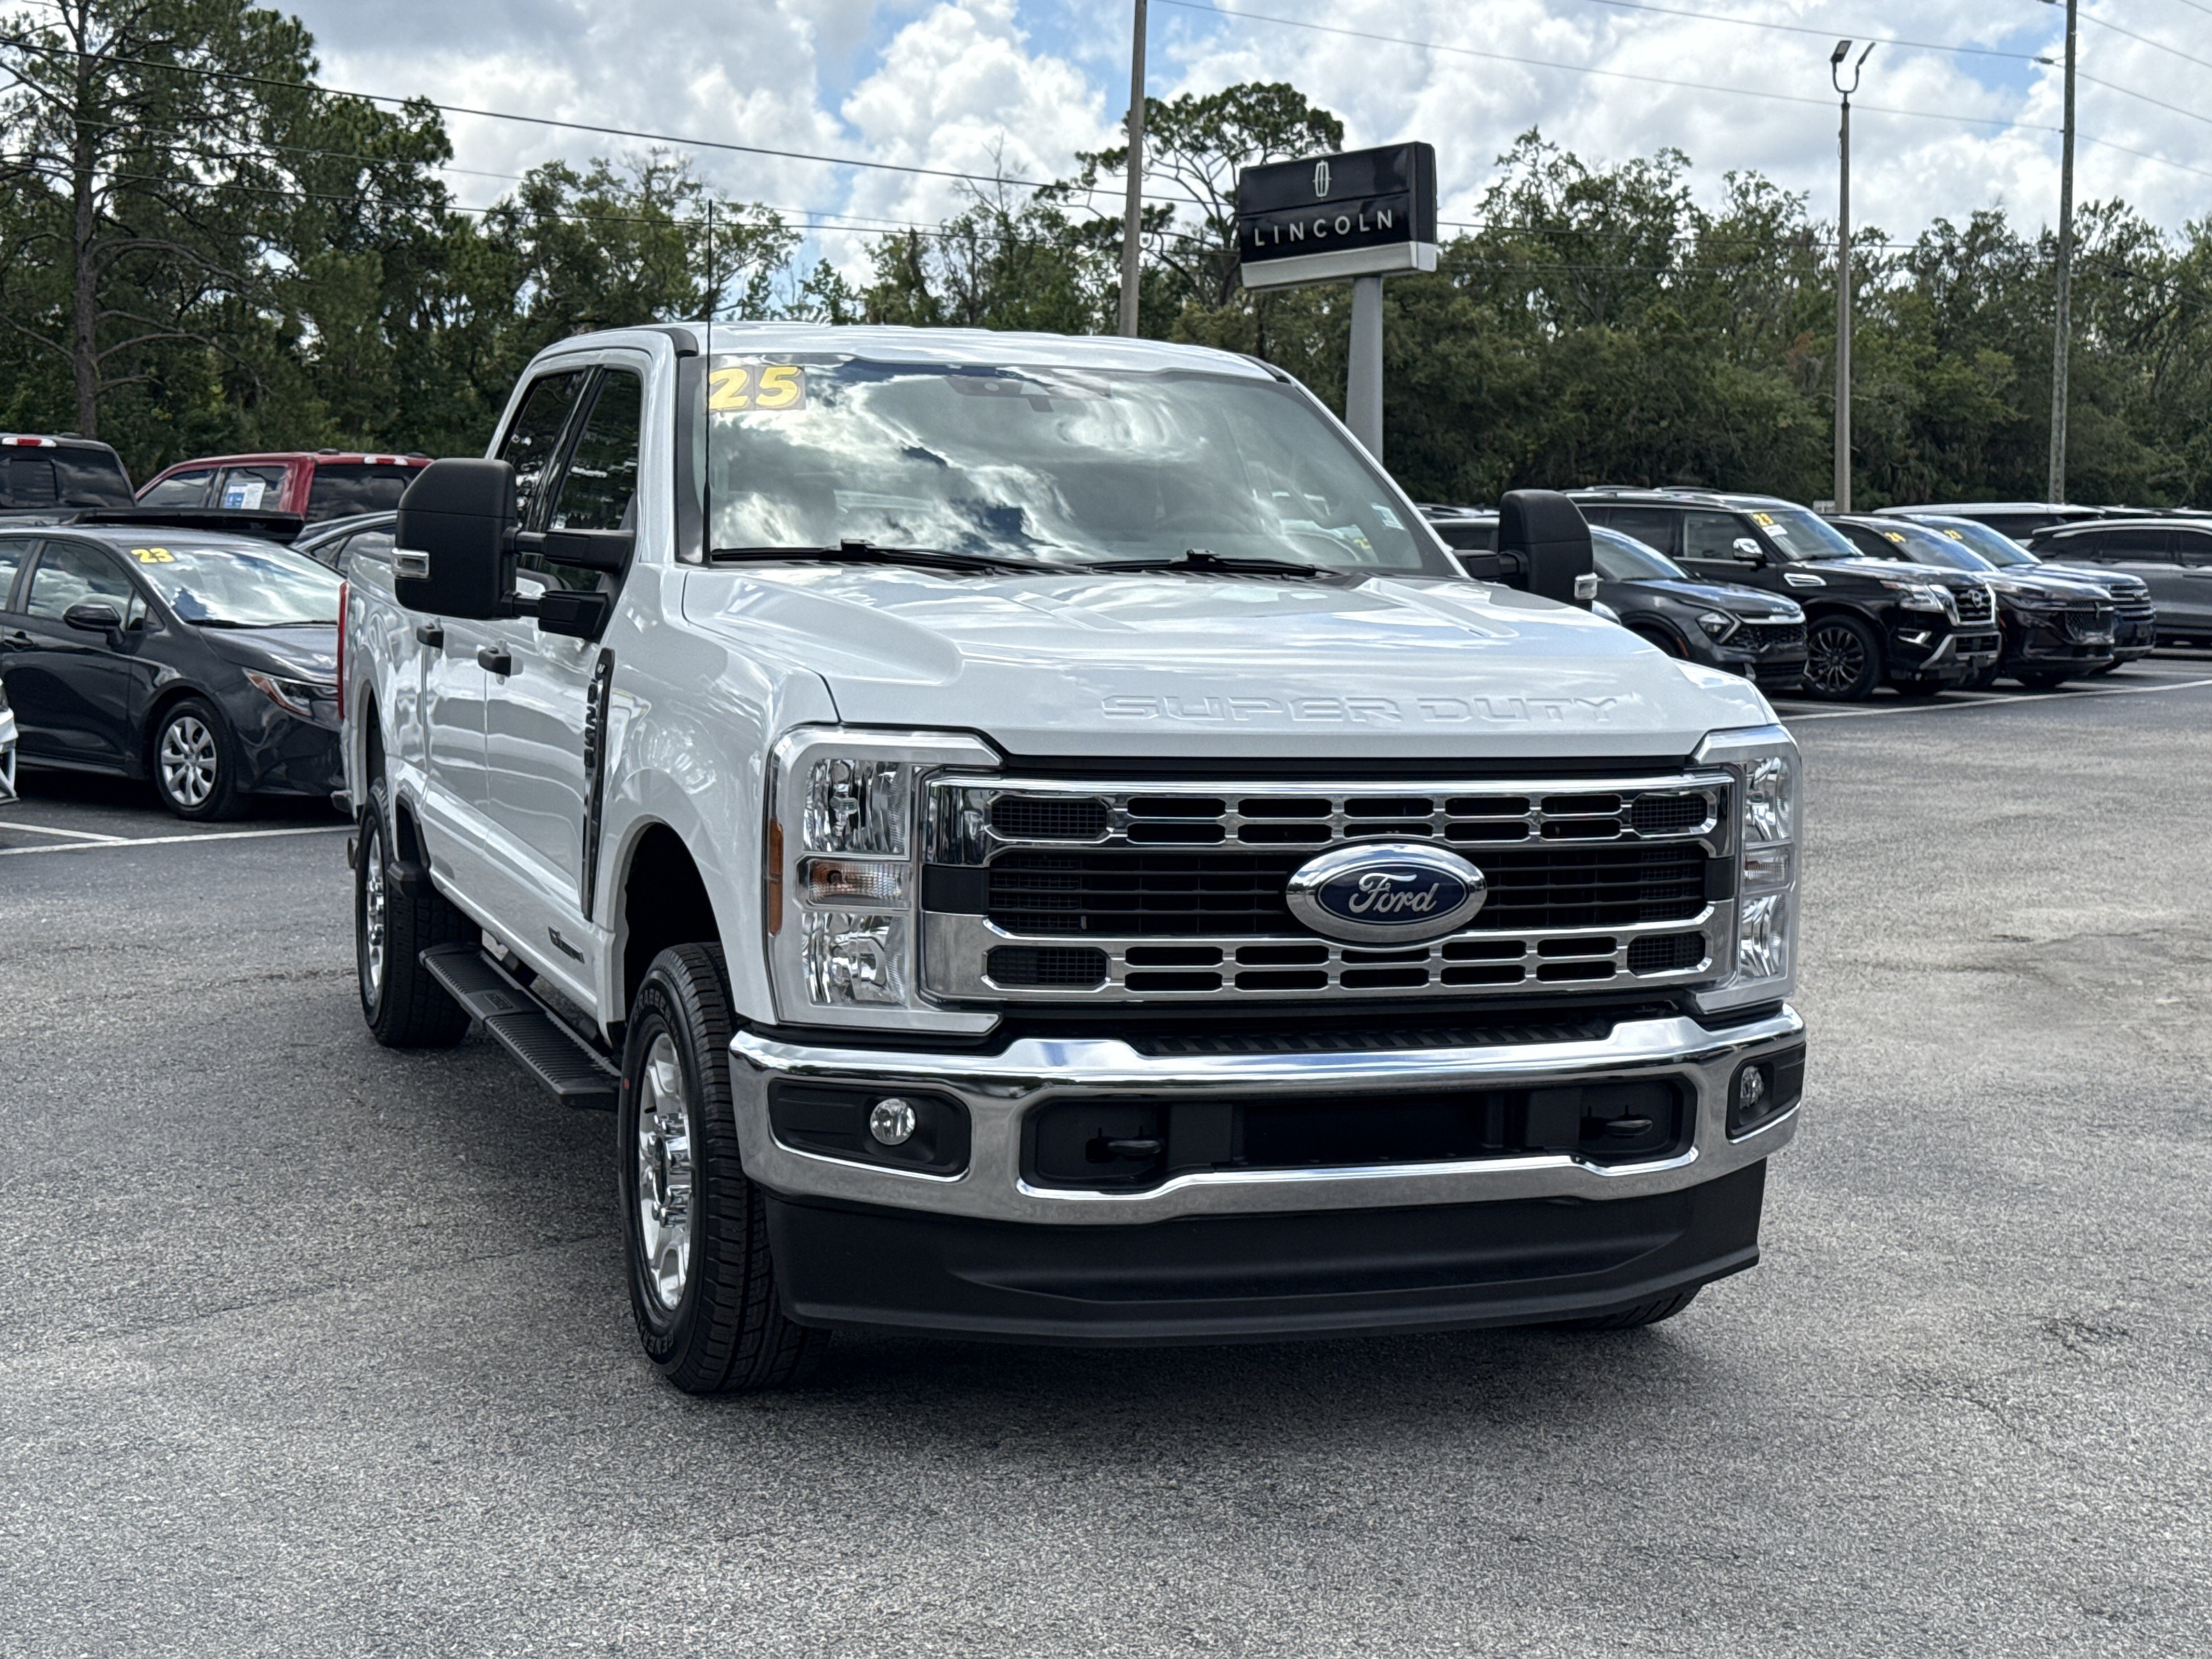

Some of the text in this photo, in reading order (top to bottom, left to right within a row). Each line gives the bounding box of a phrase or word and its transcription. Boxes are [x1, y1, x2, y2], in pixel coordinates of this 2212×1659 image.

[1254, 209, 1393, 247] LINCOLN
[709, 366, 802, 411] 25
[1753, 513, 1774, 526] 23
[131, 547, 176, 563] 23
[1101, 695, 1618, 722] SUPER DUTY
[1348, 872, 1440, 913] Ford
